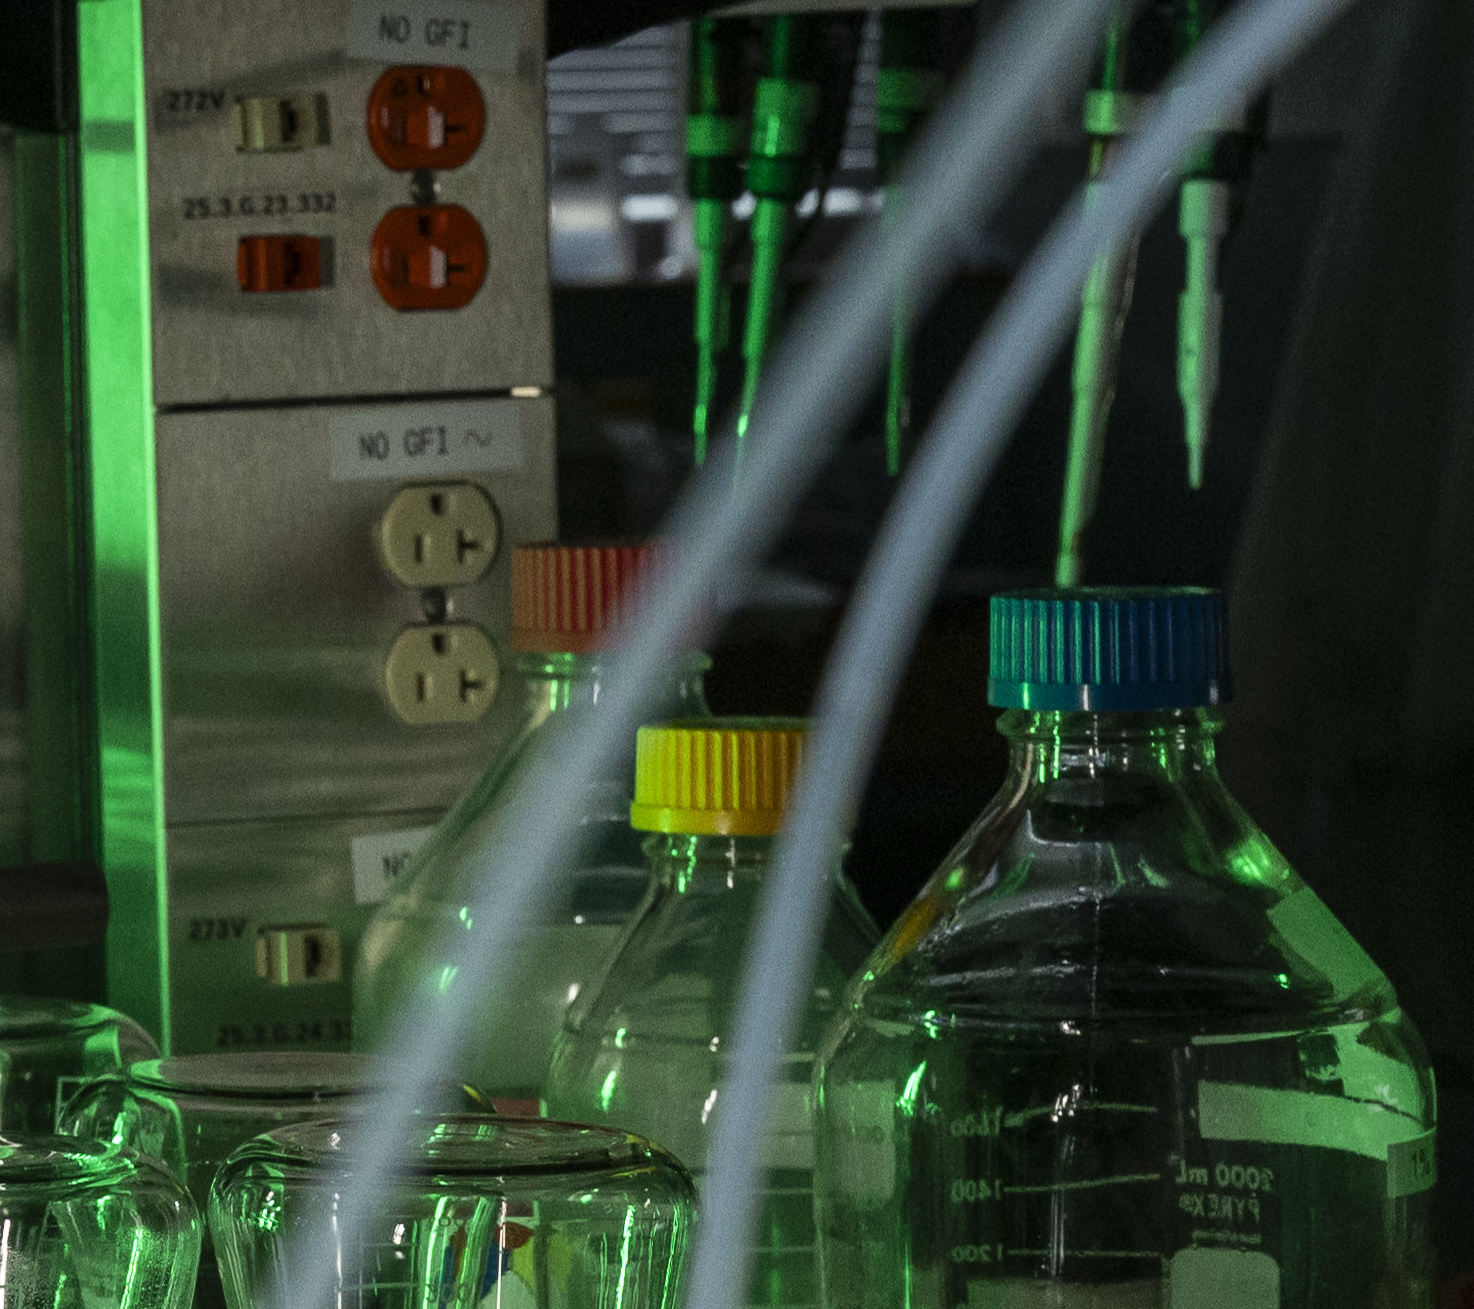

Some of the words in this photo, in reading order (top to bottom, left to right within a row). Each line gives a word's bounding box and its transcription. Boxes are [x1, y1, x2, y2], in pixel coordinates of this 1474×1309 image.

[381, 16, 411, 45] NO
[425, 17, 472, 51] GFI
[359, 434, 390, 461] NO
[403, 426, 448, 457] GFI
